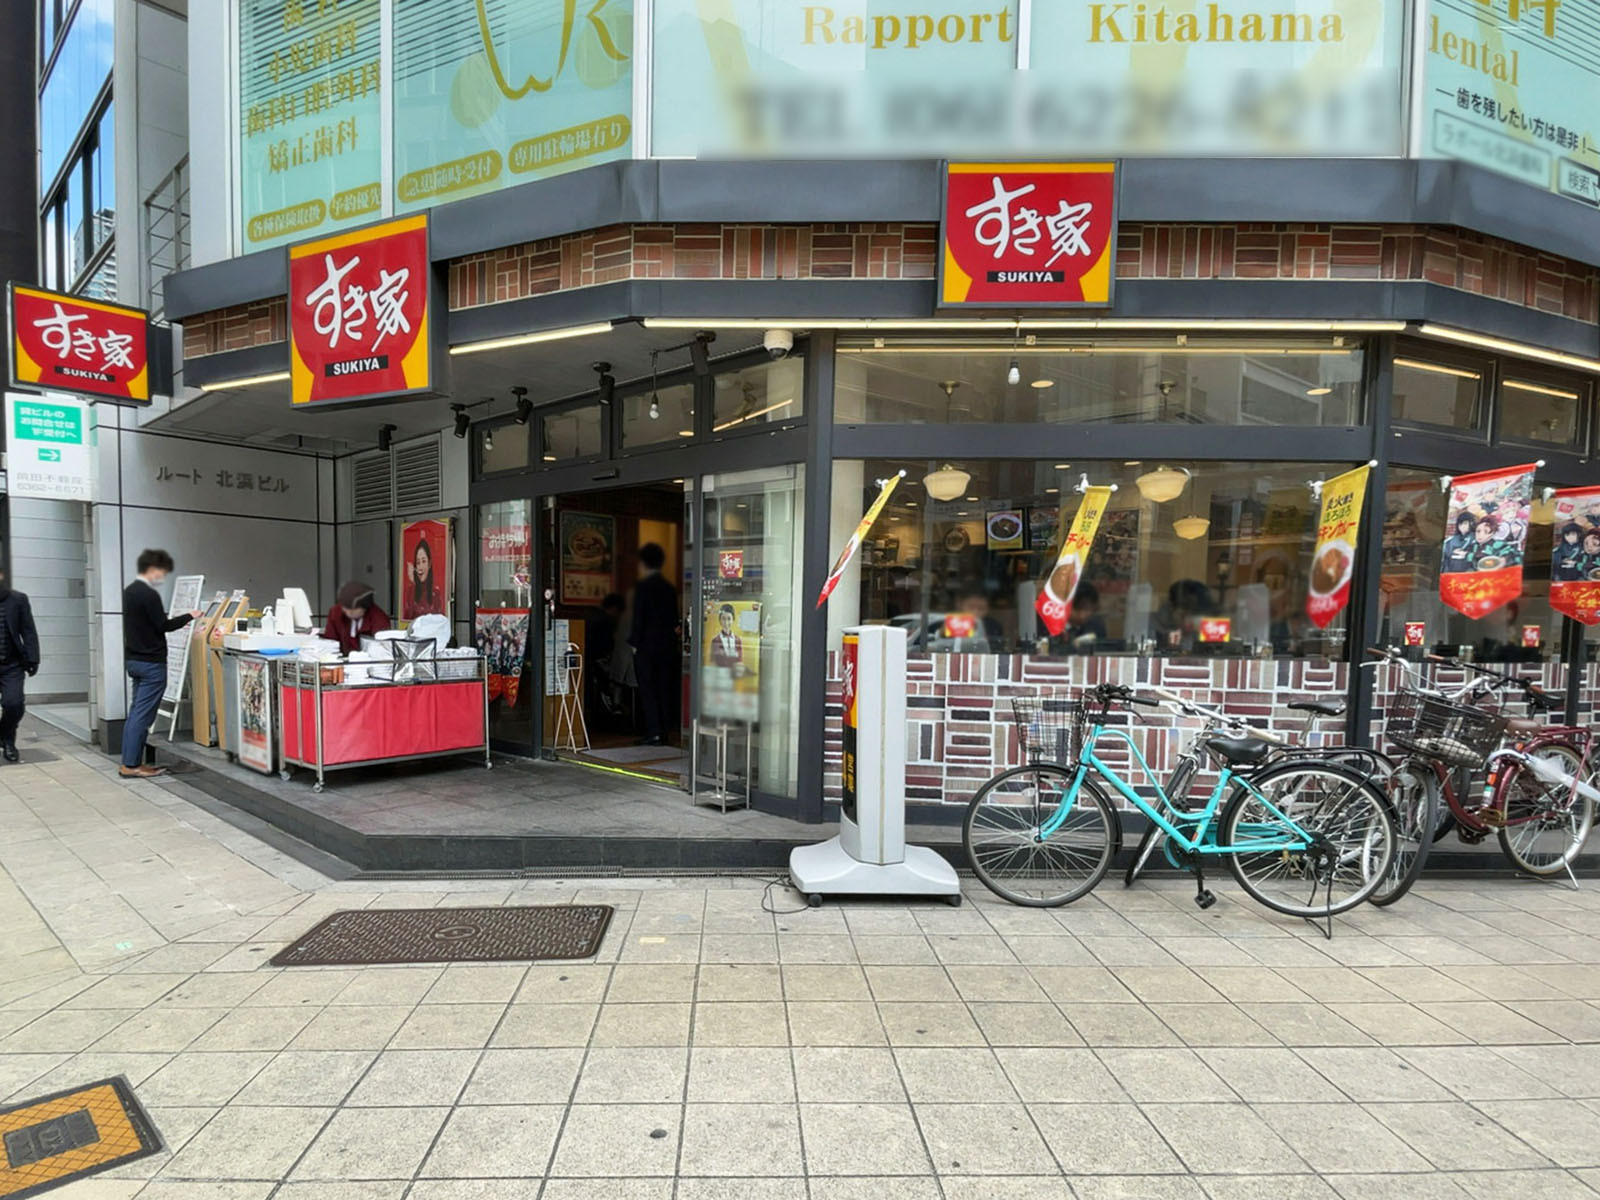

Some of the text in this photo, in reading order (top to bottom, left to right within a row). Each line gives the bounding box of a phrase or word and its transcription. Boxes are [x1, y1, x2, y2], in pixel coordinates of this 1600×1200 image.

[267, 20, 356, 84] 小児歯科
[801, 3, 1345, 49] Rapport Kitahama
[268, 115, 359, 174] 矯正歯科
[965, 176, 1092, 268] すき家
[306, 254, 411, 352] すき家
[997, 272, 1053, 282] SUKIYA
[33, 303, 134, 371] すき家
[63, 367, 108, 381] SUKIYA
[333, 357, 380, 375] SUKIYA
[156, 466, 202, 485] ルート
